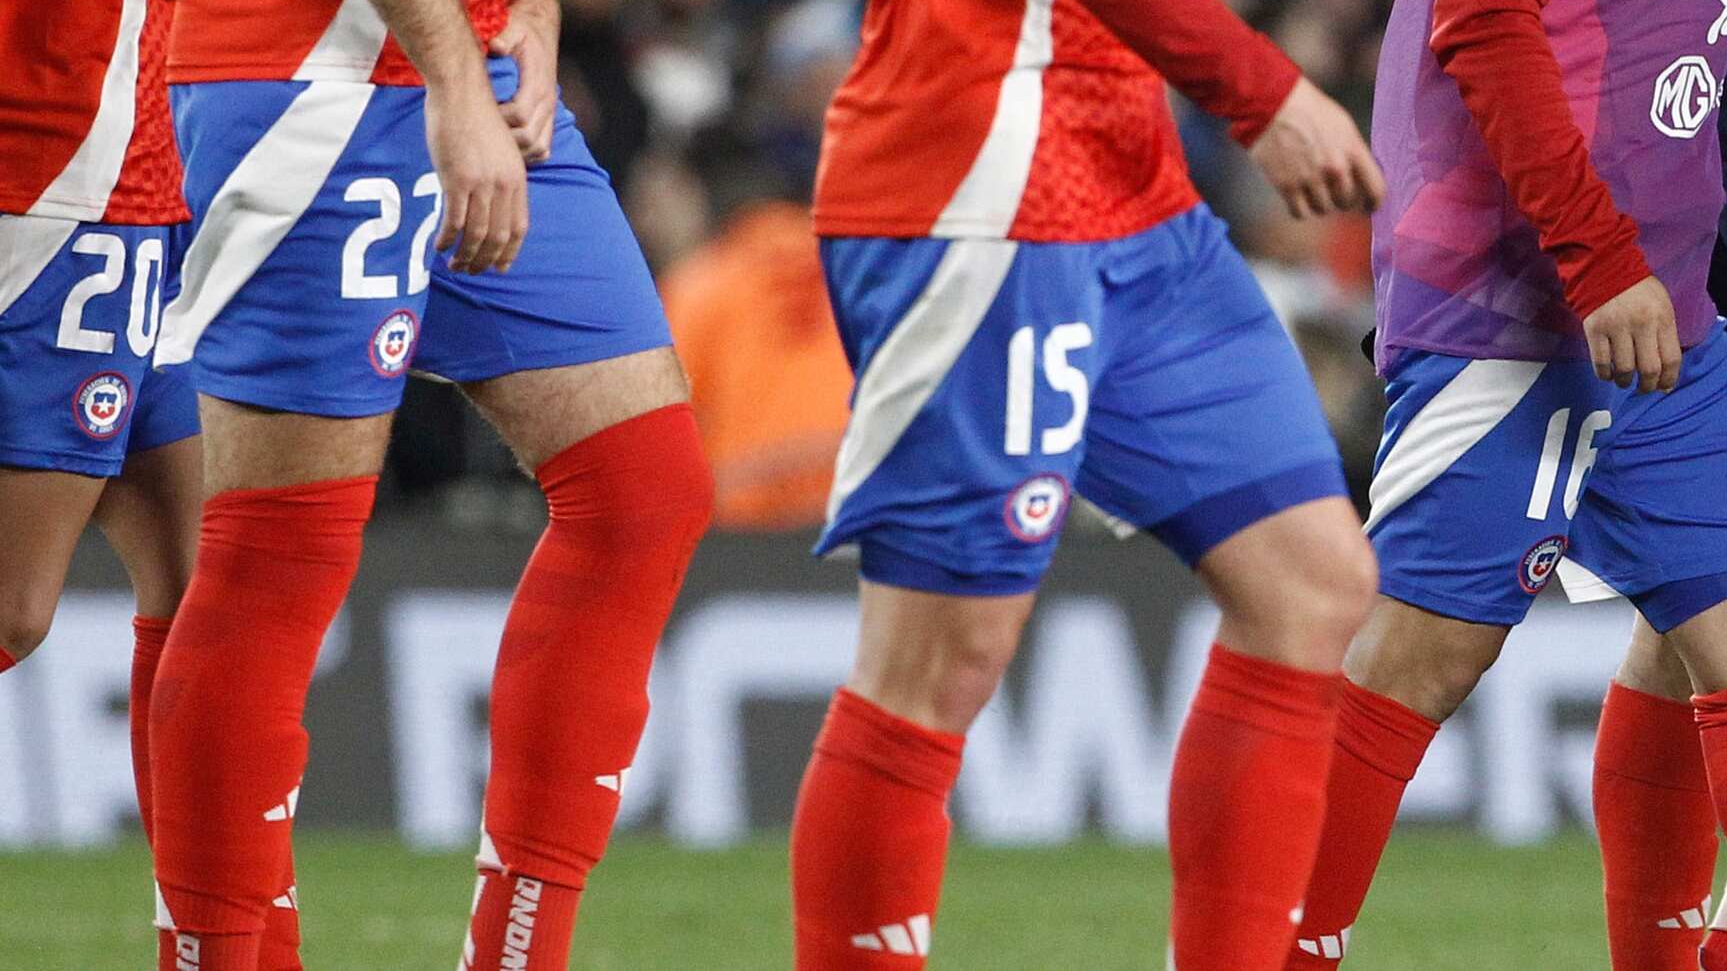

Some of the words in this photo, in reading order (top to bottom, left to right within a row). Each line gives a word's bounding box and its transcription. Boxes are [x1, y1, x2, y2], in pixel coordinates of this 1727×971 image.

[57, 232, 162, 355] 20
[341, 172, 443, 300] 22
[1003, 322, 1093, 456] 15
[1526, 408, 1613, 522] 16
